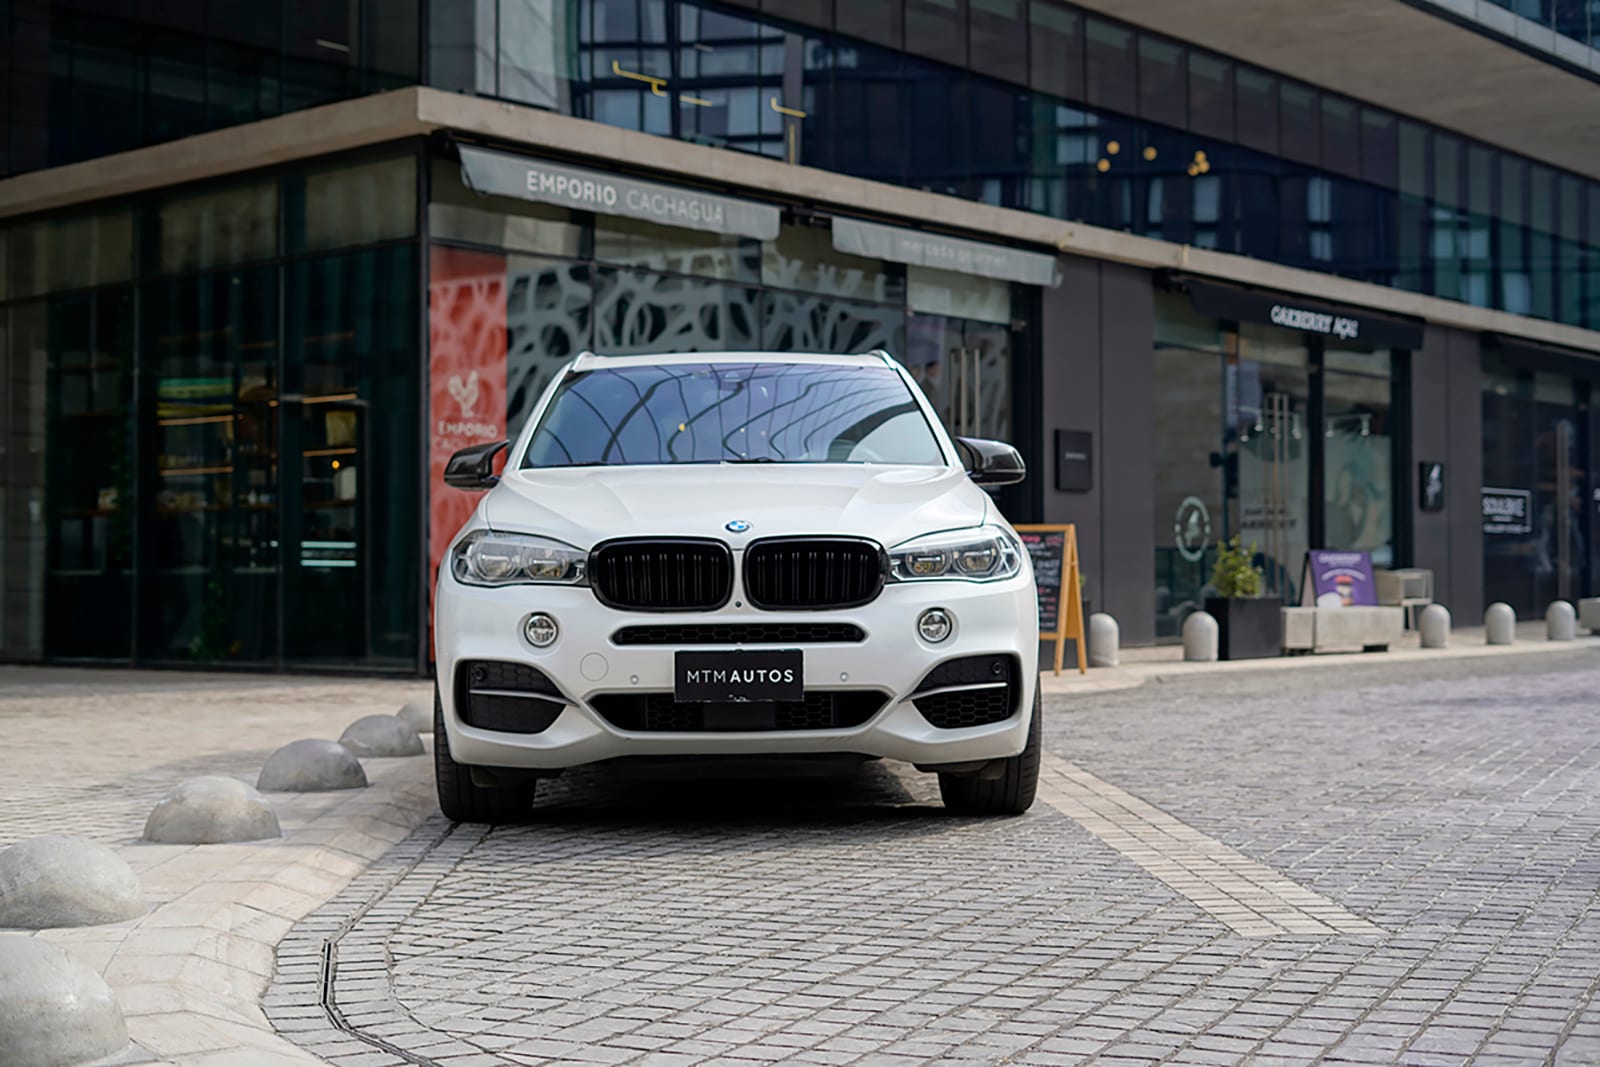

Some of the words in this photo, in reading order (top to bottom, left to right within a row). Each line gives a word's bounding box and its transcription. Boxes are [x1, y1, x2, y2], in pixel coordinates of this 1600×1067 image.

[526, 170, 617, 206] EMPORIO
[626, 189, 724, 224] CACHAGUA
[438, 421, 498, 438] EMPORIO
[687, 669, 793, 683] MTMAUTOS
